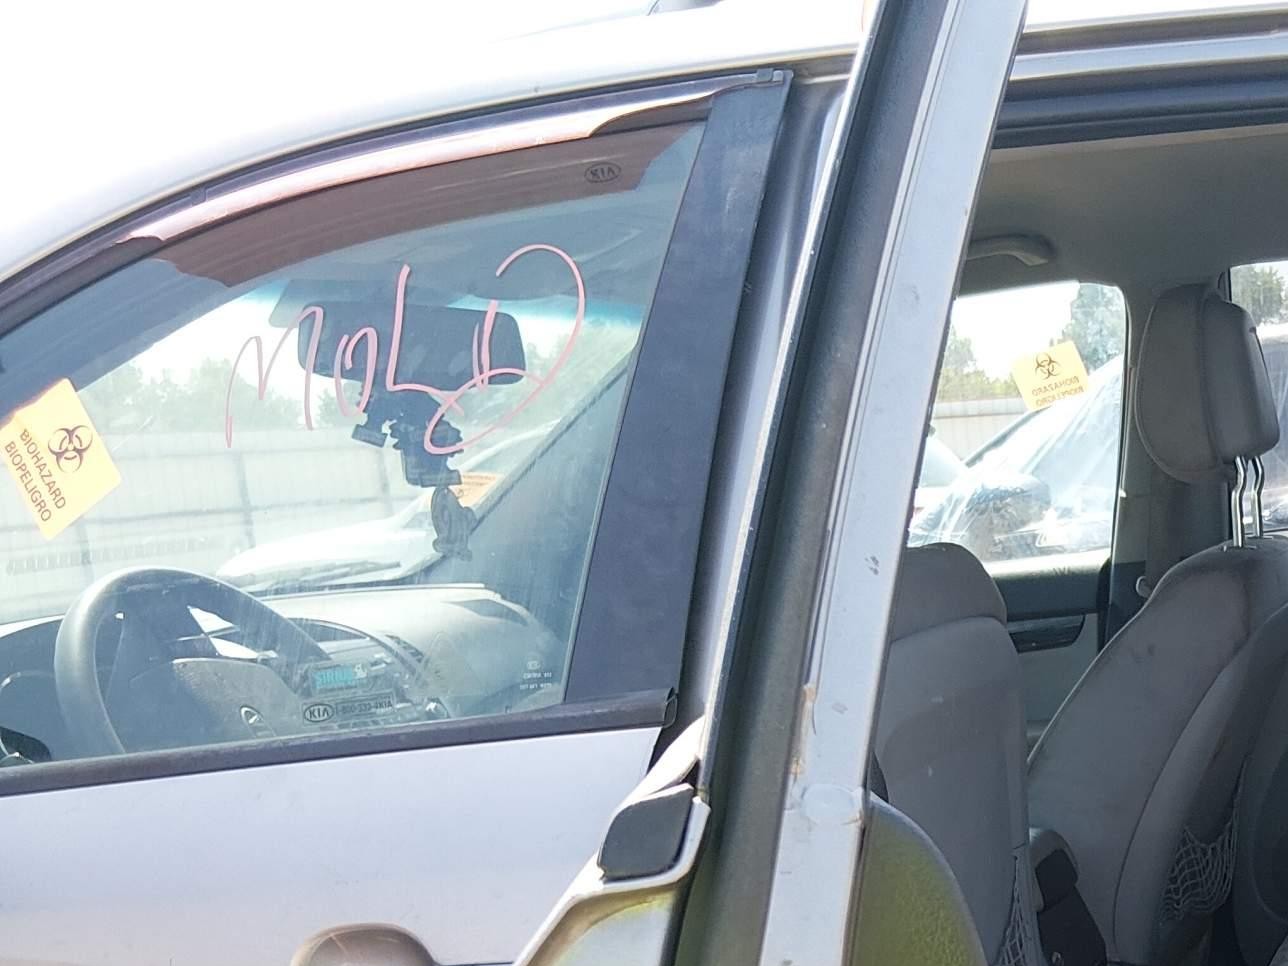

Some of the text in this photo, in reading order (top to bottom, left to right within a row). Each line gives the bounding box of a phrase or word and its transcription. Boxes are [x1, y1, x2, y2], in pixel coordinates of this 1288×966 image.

[588, 164, 618, 181] KIA
[226, 244, 586, 455] MOLD
[4, 441, 52, 522] BIOPELIGRO
[19, 429, 66, 509] BIOHAZARD
[307, 705, 331, 720] KIA
